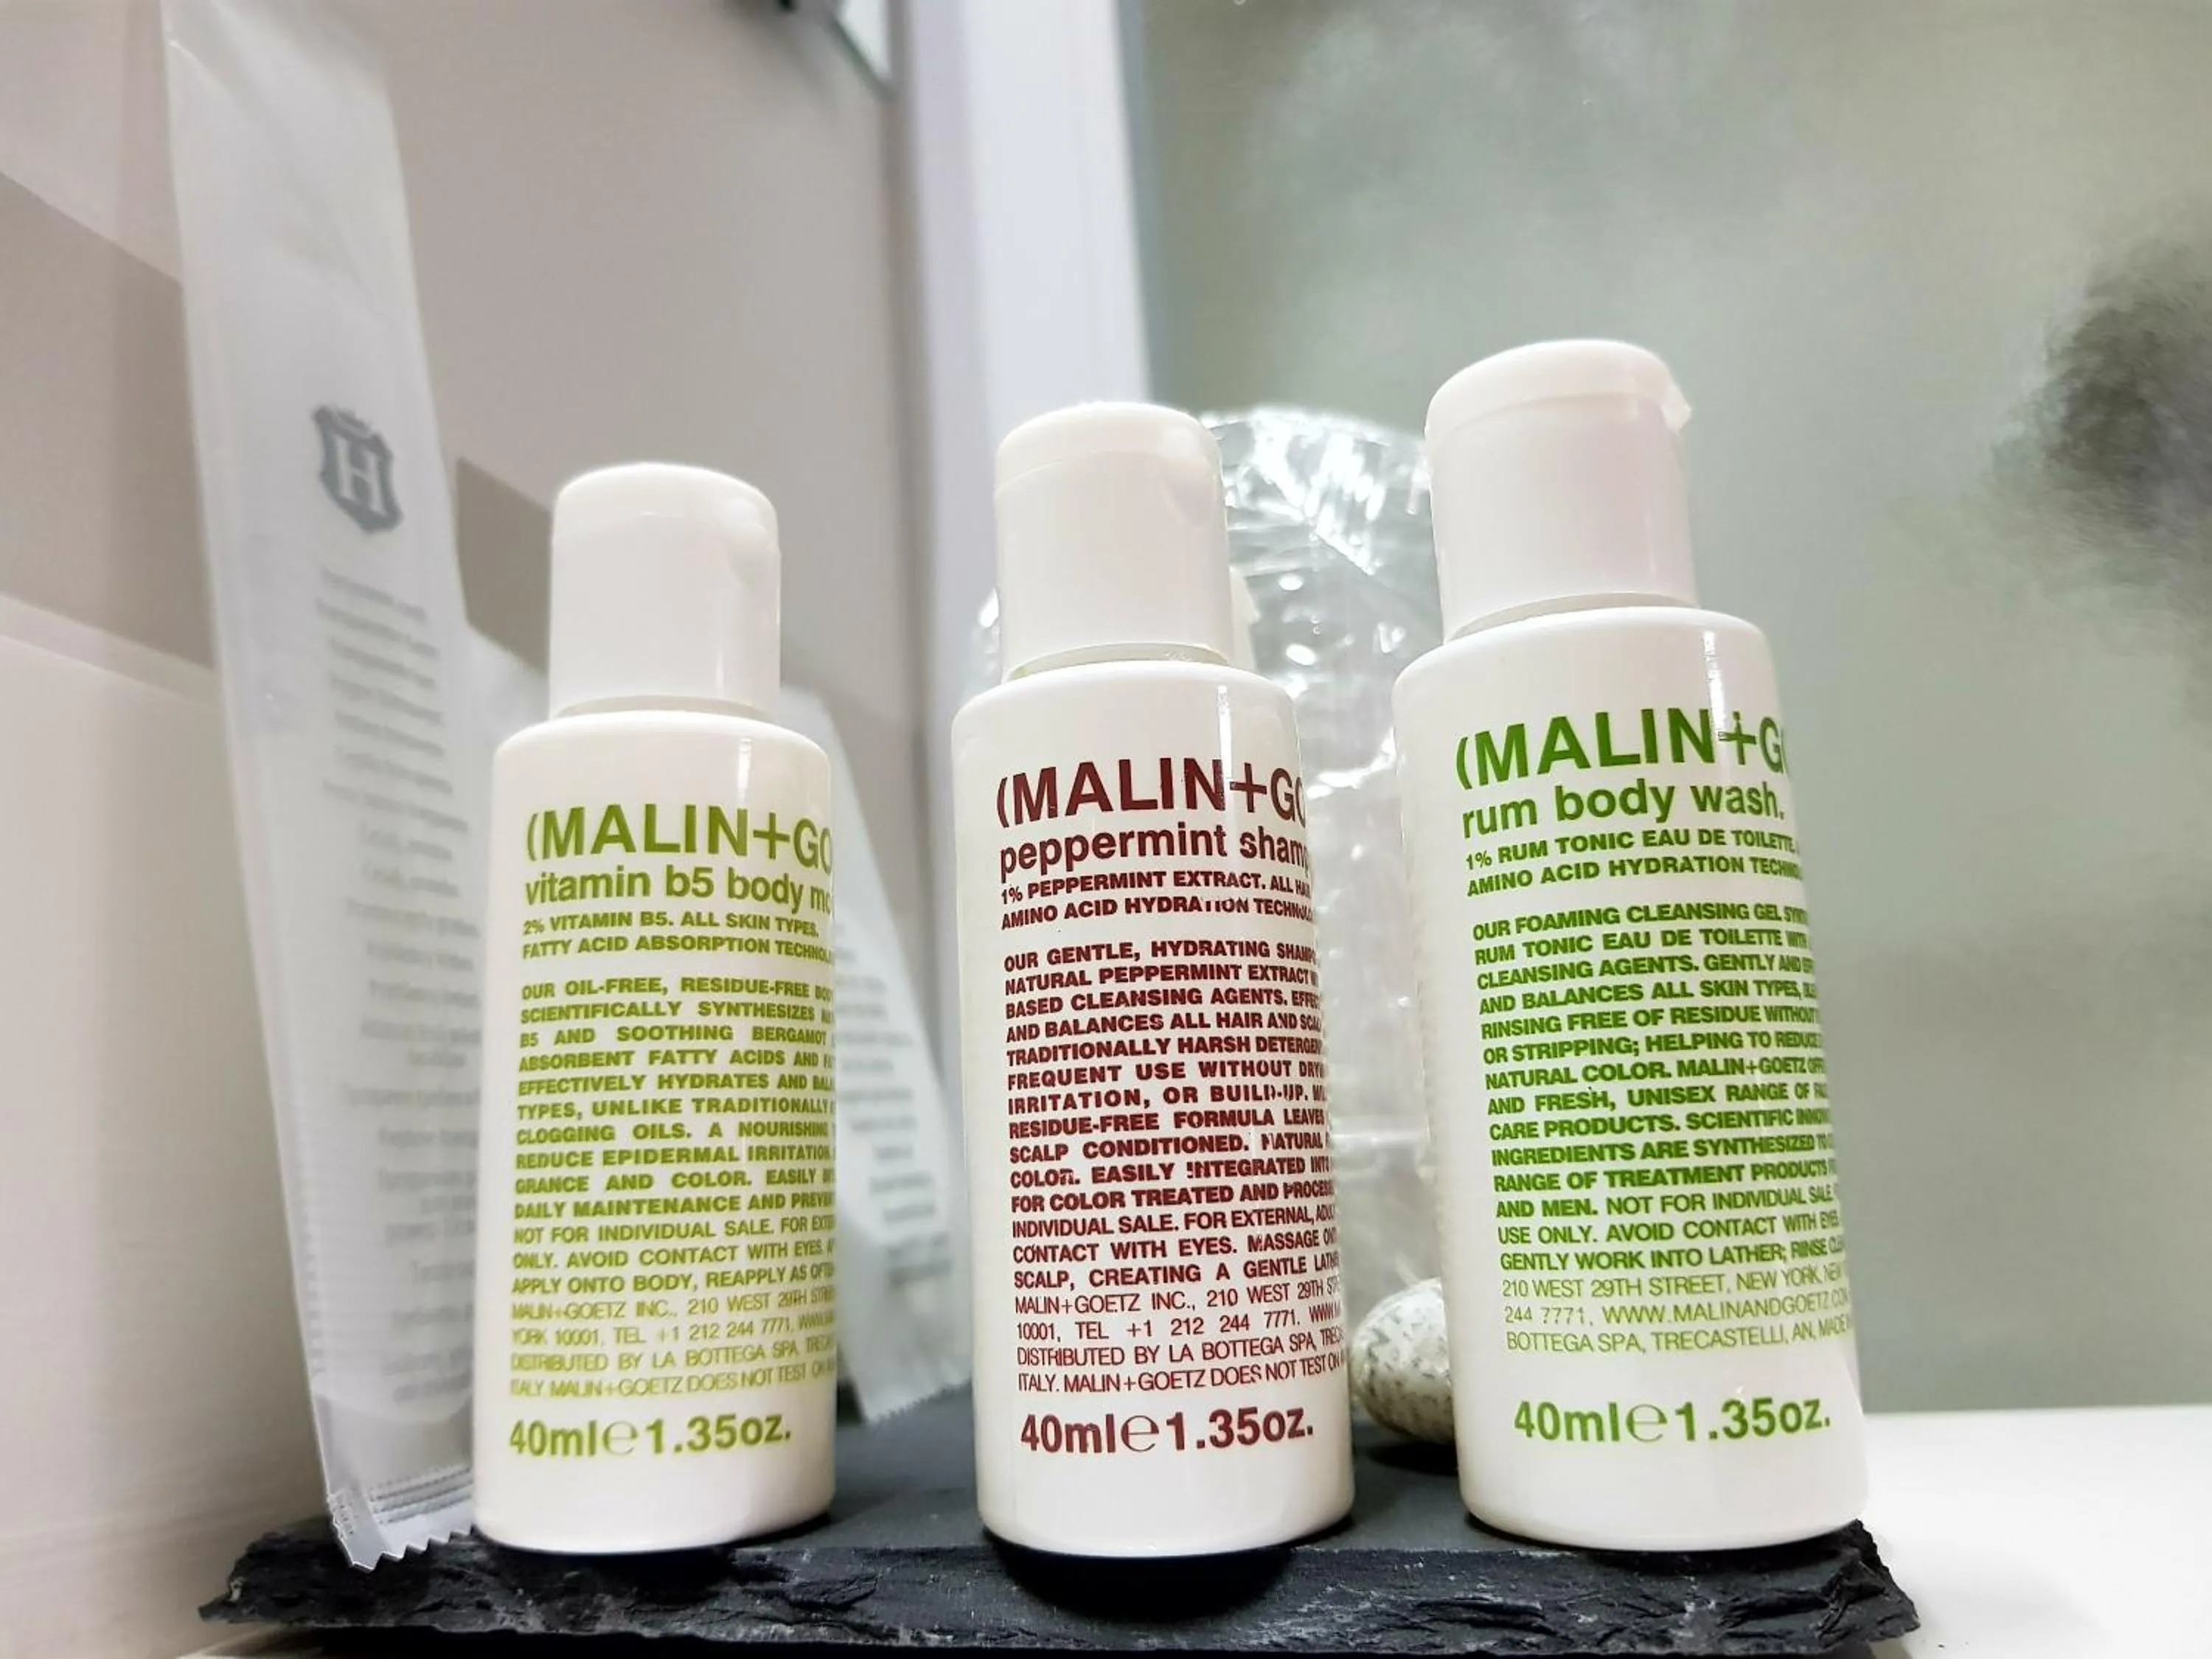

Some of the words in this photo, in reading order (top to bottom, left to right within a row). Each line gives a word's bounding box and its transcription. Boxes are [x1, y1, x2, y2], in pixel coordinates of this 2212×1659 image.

[1463, 797, 1537, 838] rum
[1556, 779, 1674, 823] body
[1691, 782, 1784, 820] wash.
[1000, 822, 1228, 883] peppermint
[1466, 854, 1492, 870] 1%
[1498, 841, 1547, 863] RUM
[1555, 832, 1634, 855] TONIC
[1642, 830, 1690, 846] EAU
[1698, 830, 1725, 845] DE
[526, 866, 650, 905] vitamin
[666, 866, 714, 898] b5
[727, 867, 803, 914] body
[1001, 886, 1023, 905] 1%
[1028, 872, 1166, 899] PEPPERMINT
[1173, 872, 1265, 889] EXTRACT.
[1270, 875, 1293, 893] ALL
[1467, 871, 1533, 897] AMINO
[1540, 863, 1599, 884] ACID
[1609, 857, 1744, 877] HYDRATION
[524, 920, 545, 936] 2%
[550, 912, 632, 931] VITAMIN
[640, 911, 672, 927] B5.
[681, 913, 719, 927] ALL
[726, 914, 770, 931] SKIN
[1001, 905, 1057, 930] AMINO
[1065, 899, 1117, 919] ACID
[1125, 896, 1249, 914] HYDRATION
[1473, 920, 1511, 941] OUR
[1516, 908, 1620, 934] FOAMING
[1627, 904, 1749, 922] CLEANSING
[1754, 905, 1781, 922] GEL
[523, 940, 571, 959] FATTY
[578, 936, 628, 954] ACID
[636, 936, 769, 954] ABSORPTION
[1004, 953, 1038, 973] OUR
[1047, 942, 1141, 965] GENTLE,
[1151, 941, 1270, 958] HYDRATING
[1099, 965, 1242, 984] PEPPERMINT
[1248, 965, 1309, 984] EXTRACT
[1478, 961, 1593, 990] CLEANSING
[1599, 956, 1698, 978] AGENTS.
[1704, 954, 1775, 971] GENTLY
[522, 984, 554, 1001] OUR
[566, 978, 668, 995] OIL-FREE,
[681, 978, 810, 997] RESIDUE-FREE
[1523, 984, 1643, 1009] BALANCES
[1652, 982, 1694, 999] ALL
[1700, 981, 1749, 998] SKIN
[521, 1002, 681, 1024] SCIENTIFICALLY
[698, 1002, 814, 1020] SYNTHESIZES
[1006, 997, 1062, 1019] BASED
[1071, 989, 1203, 1011] CLEANSING
[1211, 989, 1287, 1006] AGENTS.
[554, 1029, 595, 1046] AND
[616, 1026, 733, 1041] SOOTHING
[1481, 1016, 1561, 1040] RINSING
[1567, 1011, 1628, 1031] FREE
[1671, 1006, 1761, 1024] RESIDUE
[519, 1051, 635, 1072] ABSORBENT
[649, 1050, 717, 1065] FATTY
[730, 1050, 785, 1065] ACIDS
[794, 1051, 818, 1067] AND
[1007, 1038, 1171, 1067] TRADITIONALLY
[1178, 1036, 1251, 1054] HARSH
[1512, 1037, 1639, 1062] STRIPPING;
[1646, 1033, 1743, 1053] HELPING
[518, 1075, 646, 1096] EFFECTIVELY
[658, 1074, 768, 1090] HYDRATES
[1008, 1065, 1121, 1091] FREQUENT
[1135, 1062, 1186, 1079] USE
[1198, 1061, 1292, 1078] WITHOUT
[1582, 1062, 1671, 1082] COLOR.
[518, 1101, 582, 1120] TYPES,
[593, 1099, 681, 1116] UNLIKE
[1008, 1088, 1150, 1116] IRRITATION,
[1535, 1091, 1615, 1112] FRESH,
[1627, 1085, 1715, 1107] UNISEX
[1726, 1082, 1788, 1102] RANGE
[517, 1125, 614, 1145] CLOGGING
[633, 1124, 692, 1139] OILS.
[709, 1123, 722, 1138] A
[1009, 1113, 1159, 1138] RESIDUE-FREE
[1174, 1110, 1274, 1129] FORMULA
[1544, 1115, 1680, 1138] PRODUCTS.
[1686, 1109, 1793, 1130] SCIENTIFIC
[516, 1150, 592, 1169] REDUCE
[602, 1147, 738, 1166] EPIDERMAL
[1010, 1144, 1068, 1164] SCALP
[1082, 1136, 1249, 1159] CONDITIONED.
[516, 1176, 588, 1194] GRANCE
[606, 1174, 653, 1191] AND
[671, 1171, 752, 1189] COLOR.
[766, 1169, 815, 1186] EASILY
[1604, 1164, 1745, 1187] TREATMENT
[515, 1201, 566, 1220] DAILY
[574, 1197, 740, 1217] MAINTENANCE
[1050, 1191, 1125, 1211] COLOR
[1131, 1186, 1233, 1207] TREATED
[1542, 1197, 1598, 1217] MEN.
[1607, 1196, 1652, 1215] NOT
[1660, 1194, 1705, 1214] FOR
[1712, 1187, 1806, 1210] INDIVIDUAL
[1012, 1218, 1113, 1238] INDIVIDUAL
[1119, 1215, 1178, 1235] SALE.
[1232, 1206, 1315, 1227] EXTERNAL,
[567, 1251, 628, 1267] AVOID
[639, 1247, 737, 1265] CONTACT
[1013, 1243, 1099, 1263] CONTACT
[1111, 1239, 1166, 1260] WITH
[1179, 1236, 1237, 1256] EYES.
[1576, 1250, 1645, 1270] WORK
[1650, 1247, 1702, 1267] INTO
[568, 1276, 625, 1293] ONTO
[633, 1273, 698, 1293] BODY,
[1015, 1270, 1074, 1290] SCALP,
[1090, 1264, 1200, 1286] CREATING
[1243, 1256, 1307, 1278] GENTLE
[1502, 1280, 1528, 1298] 210
[1532, 1280, 1585, 1298] WEST
[1591, 1276, 1641, 1298] 29TH
[1207, 1290, 1238, 1307] 210
[1248, 1284, 1290, 1304] WEST
[1298, 1279, 1324, 1299] 29TH
[1171, 1318, 1203, 1335] 212
[1220, 1315, 1250, 1332] 244
[1018, 1346, 1124, 1366] DISTRIBUTED
[1135, 1345, 1160, 1364] BY
[1169, 1344, 1194, 1362] LA
[1203, 1338, 1283, 1360] BOTTEGA
[1018, 1372, 1059, 1392] ITALY.
